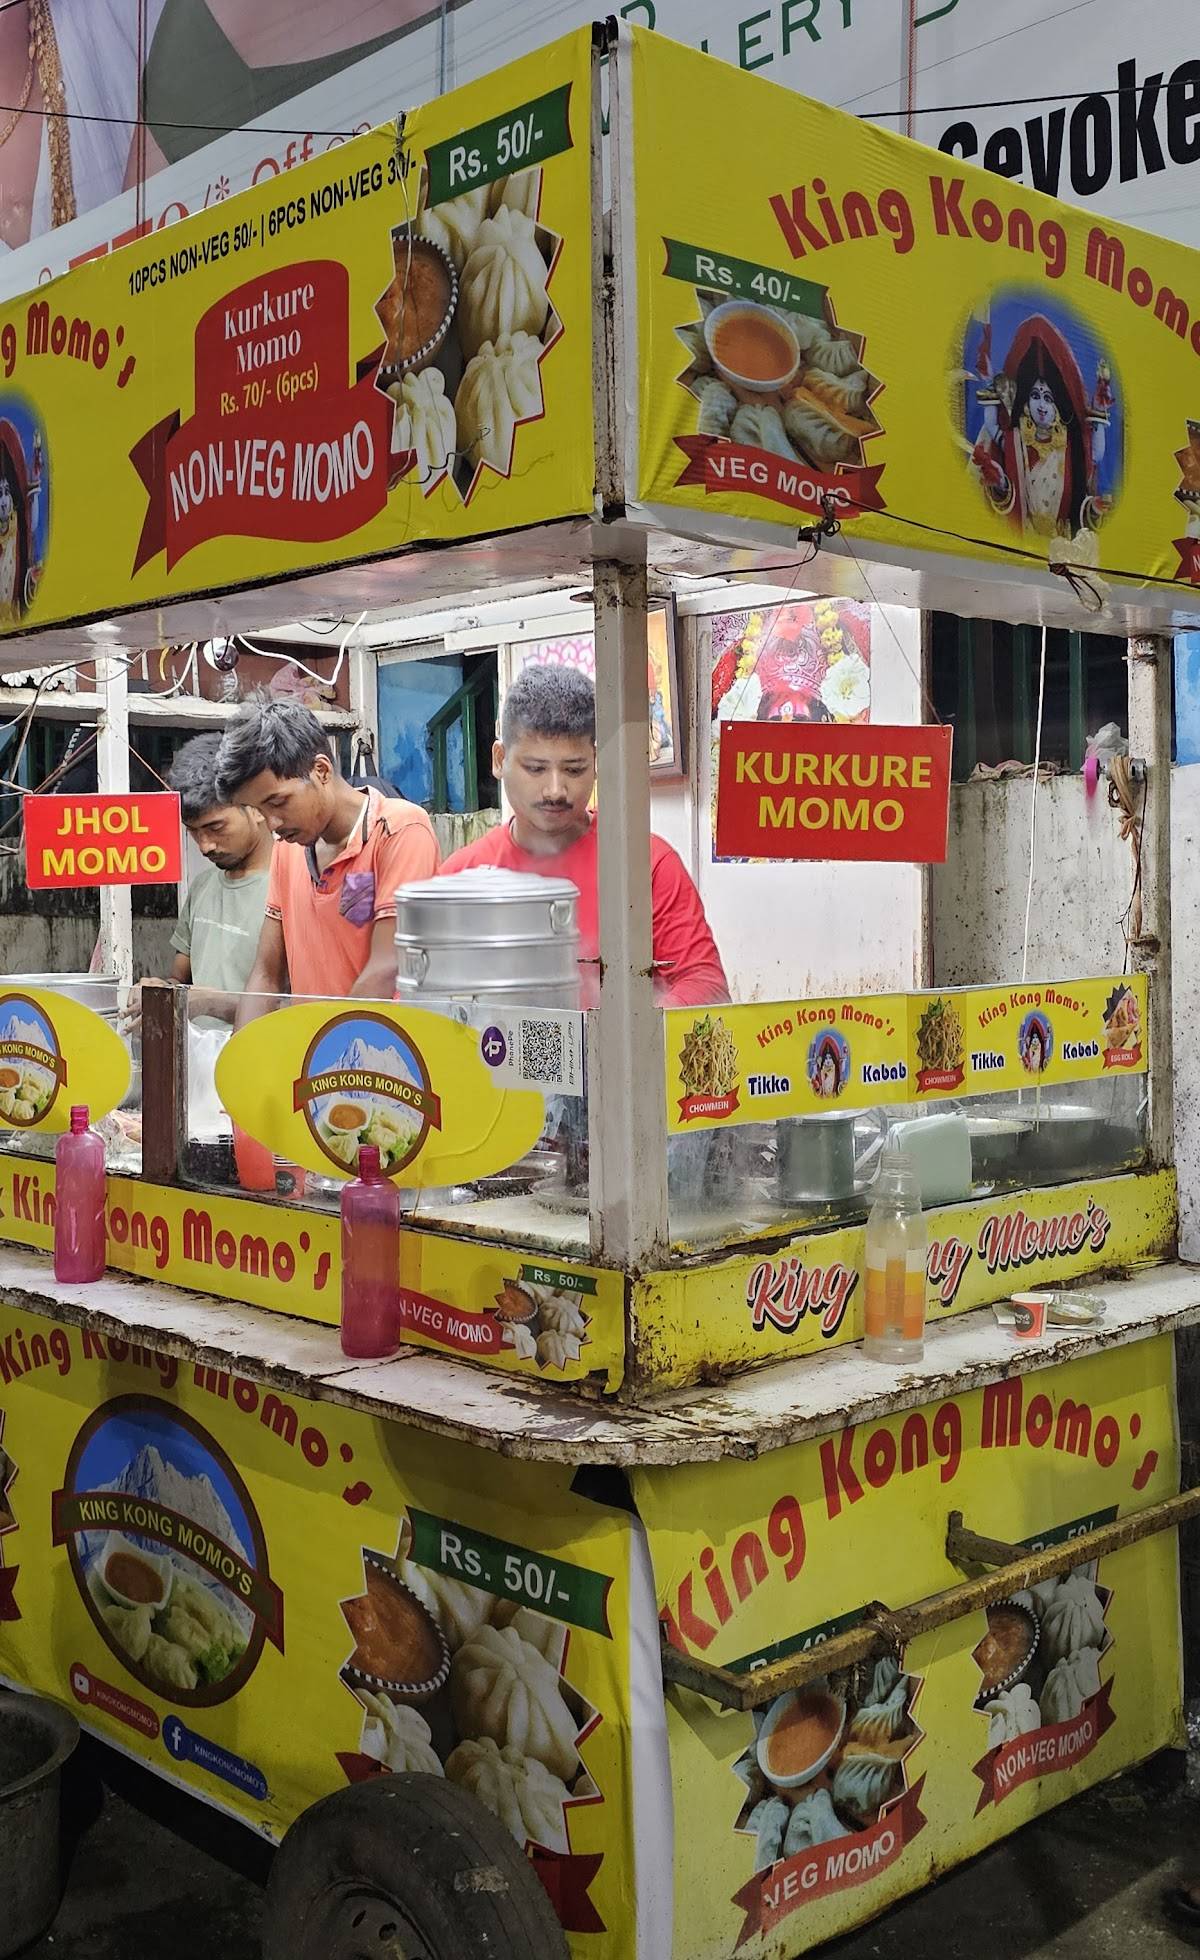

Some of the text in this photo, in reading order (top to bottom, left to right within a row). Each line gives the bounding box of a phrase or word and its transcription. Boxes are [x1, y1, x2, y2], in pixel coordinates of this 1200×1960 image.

[448, 114, 544, 187] Rs. 50/-
[129, 258, 166, 296] 10PCS
[169, 231, 229, 279] NON-VEG
[234, 219, 257, 252] 50/-
[268, 197, 305, 236] 6PCS
[310, 163, 383, 219] NON-VEG
[768, 177, 914, 260] King
[929, 175, 1068, 279] Kong
[695, 253, 801, 303] Rs. 40/-
[224, 280, 315, 341] Kurkure
[26, 301, 137, 388] Momo's
[235, 325, 301, 375] Momo
[219, 362, 319, 418] Rs. 70/- (6pcs)
[169, 420, 376, 523] NON-VEG MOMO
[708, 455, 769, 486] VEG
[735, 751, 933, 789] KURKURE
[57, 806, 149, 836] JHOL
[758, 796, 905, 832] MOMO
[42, 845, 167, 876] MOMO
[756, 1004, 895, 1048] King Kong Momo's
[978, 989, 1089, 1028] King Kong Momo's
[25, 1046, 55, 1068] MOMO'S
[748, 1062, 907, 1096] Tikka Kabab
[924, 1074, 957, 1086] CHOWMEIN
[971, 1040, 1099, 1071] Tikka Kabab
[311, 1074, 423, 1106] KING KONG MOMO'S
[689, 1100, 729, 1113] CHOWMEIN
[13, 1173, 57, 1227] Kin
[104, 1193, 169, 1269] ong
[183, 1208, 331, 1290] Momo's
[559, 1275, 583, 1288] 50/-
[747, 1196, 1111, 1335] King ng Momo's
[400, 1300, 493, 1343] N-VEG MOMO
[0, 1328, 71, 1385] King
[659, 1376, 1159, 1655] King Kong Momo's
[79, 1501, 253, 1596] KING KONG MOMO'S
[440, 1529, 571, 1605] Rs. 50/-
[995, 1721, 1095, 1788] NON-VEG MOMO
[764, 1830, 896, 1910] VEG MOMO
